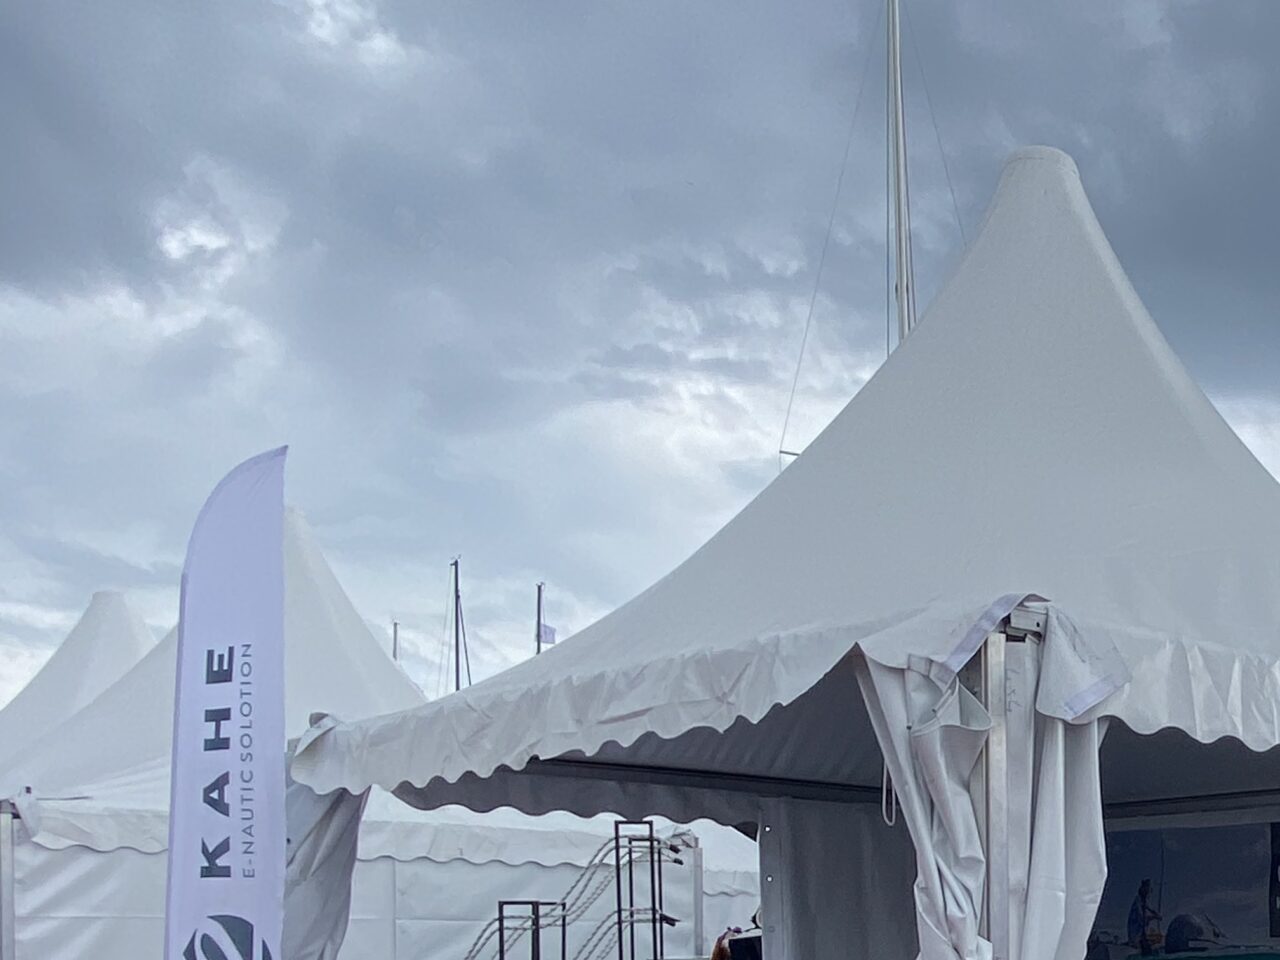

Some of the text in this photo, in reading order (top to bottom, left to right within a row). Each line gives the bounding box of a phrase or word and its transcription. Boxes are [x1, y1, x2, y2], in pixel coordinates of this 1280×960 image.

[200, 646, 234, 878] KAHE
[240, 644, 255, 878] E-NAUTIC SOLOTION
